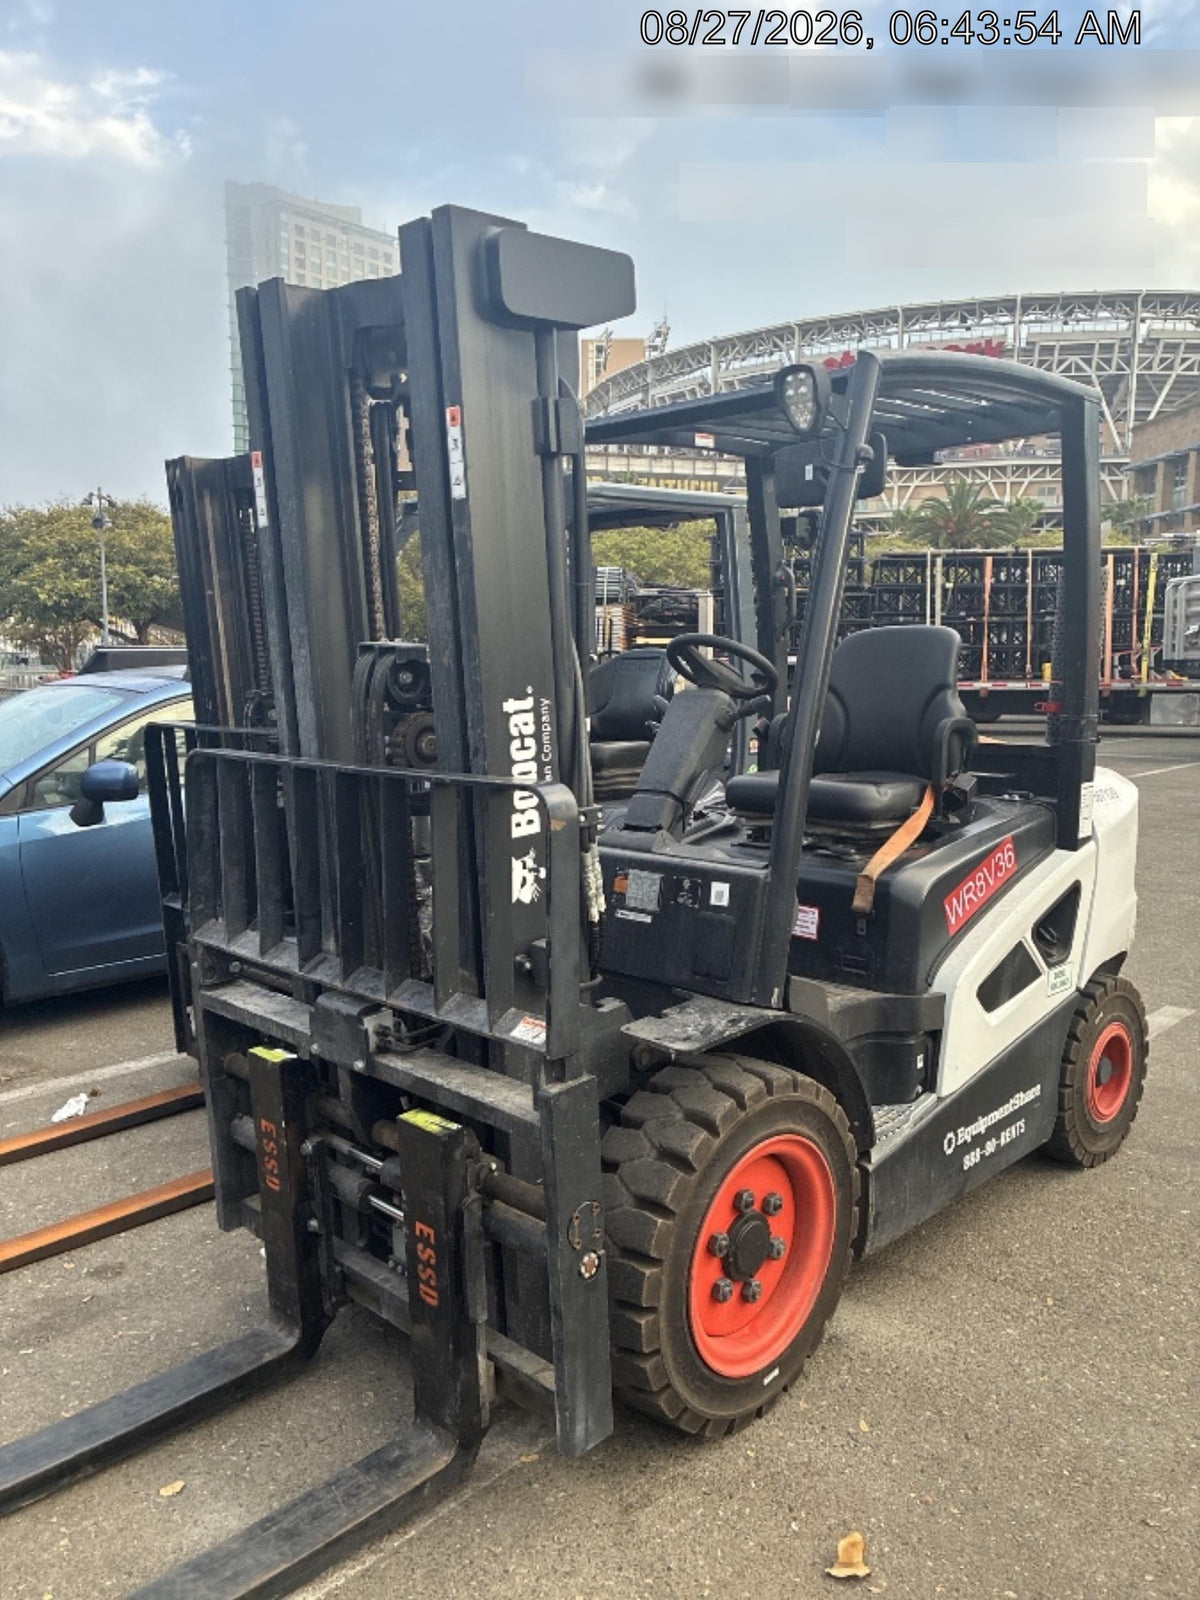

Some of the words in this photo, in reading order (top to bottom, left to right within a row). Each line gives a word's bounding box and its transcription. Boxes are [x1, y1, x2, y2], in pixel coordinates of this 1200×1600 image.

[540, 697, 552, 762] Company
[944, 843, 1015, 925] WR8V36
[956, 1083, 1041, 1146] EquipmentShare
